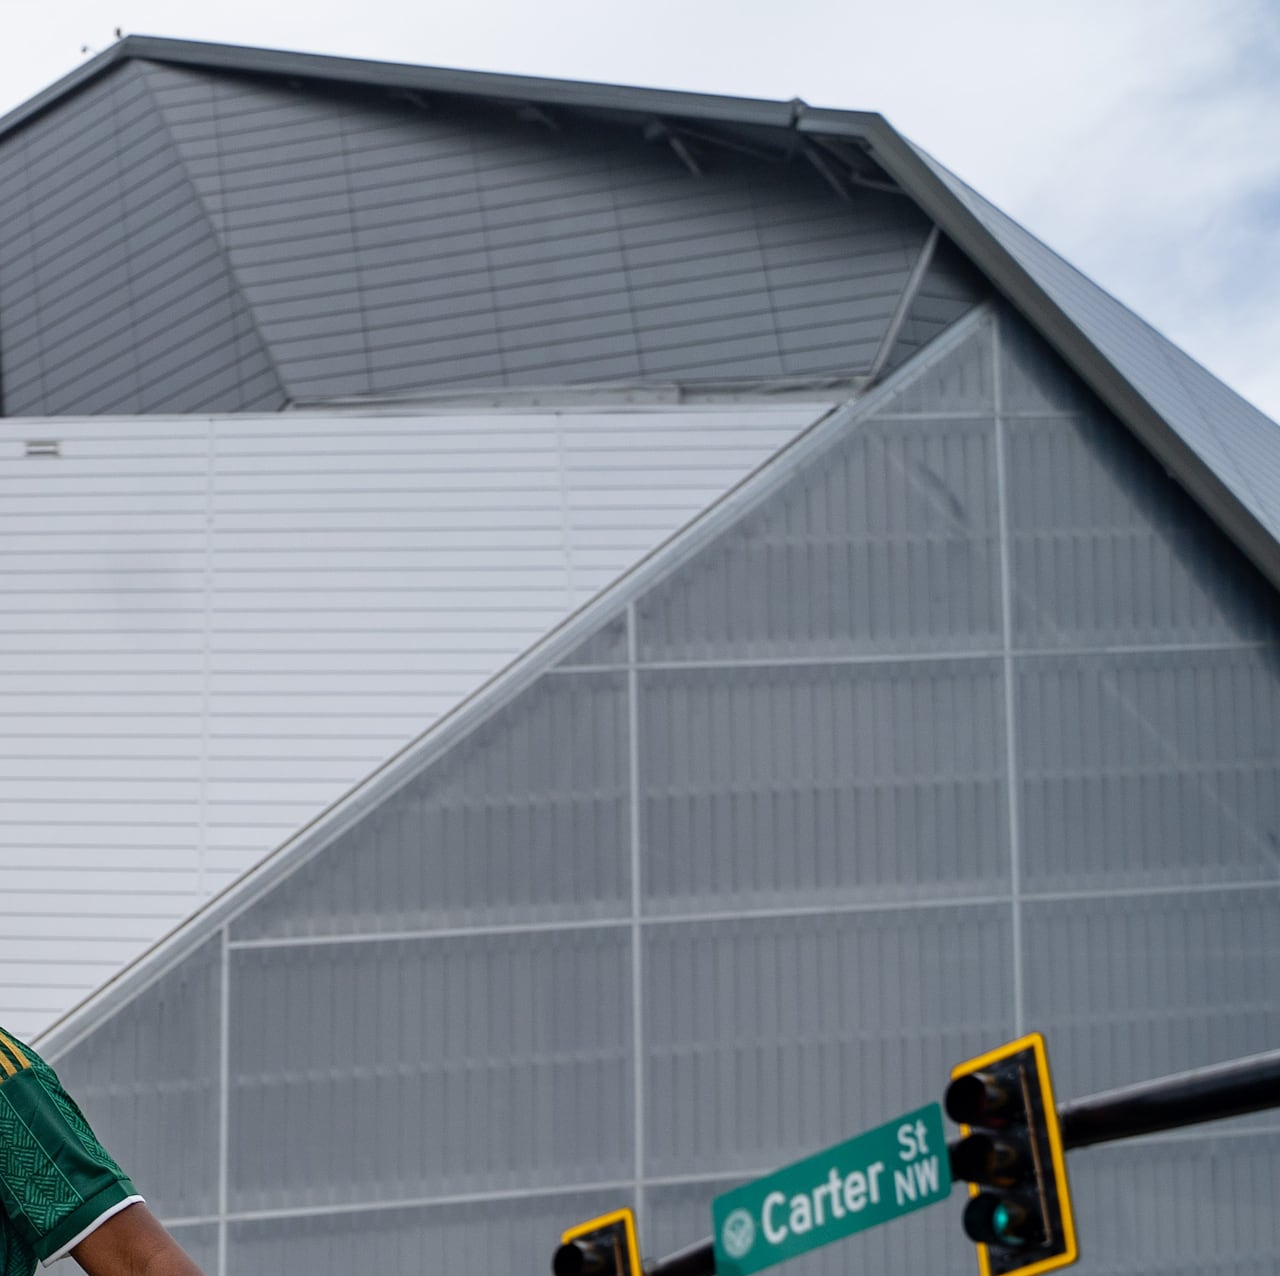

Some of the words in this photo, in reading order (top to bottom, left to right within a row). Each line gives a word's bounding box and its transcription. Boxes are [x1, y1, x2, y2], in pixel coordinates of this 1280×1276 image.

[897, 1118, 930, 1162] St
[761, 1161, 885, 1245] Carter
[893, 1154, 940, 1207] NW
